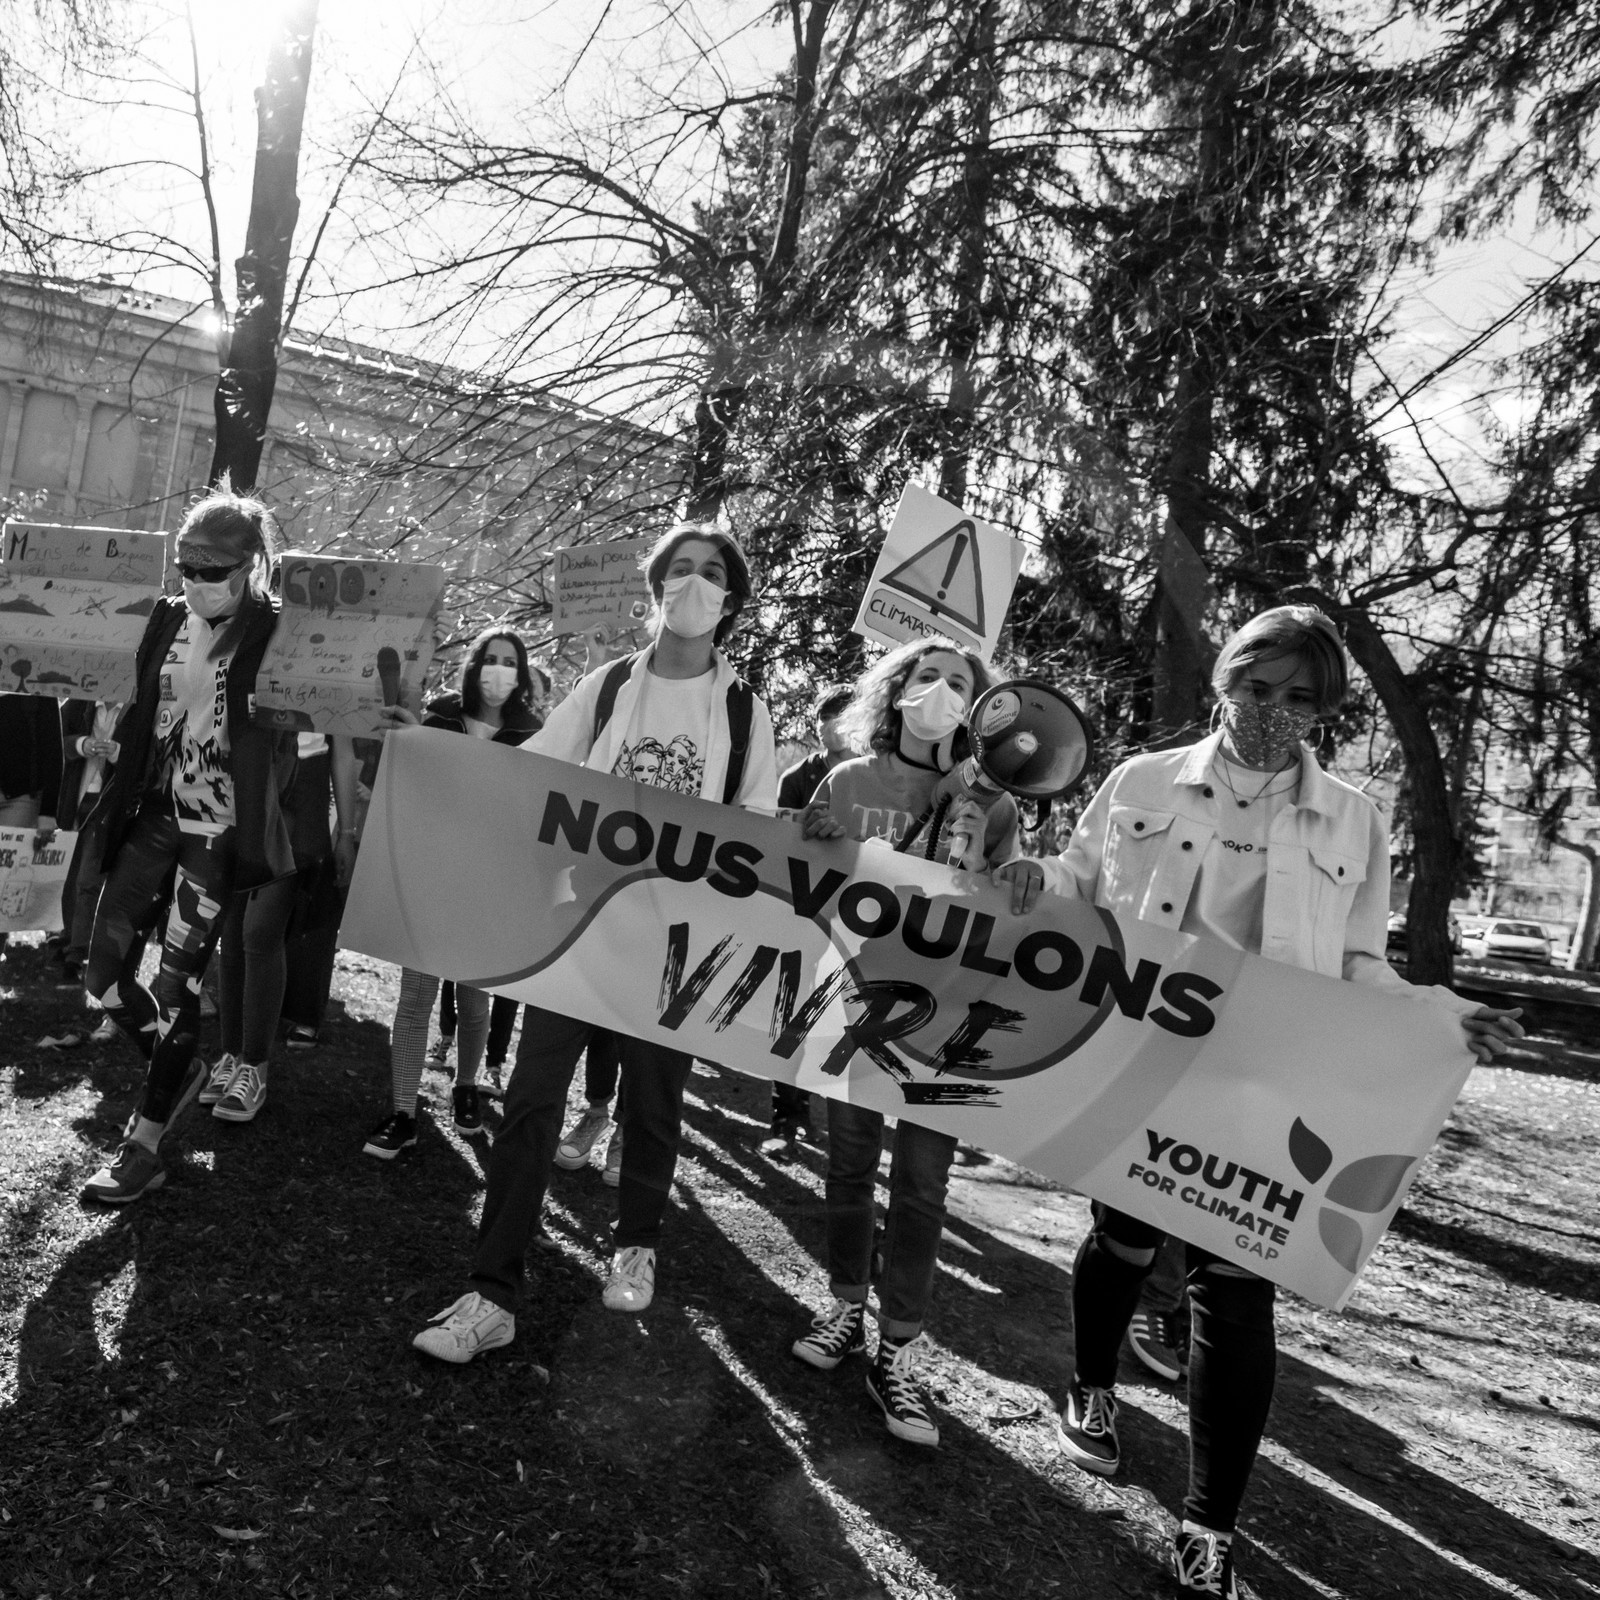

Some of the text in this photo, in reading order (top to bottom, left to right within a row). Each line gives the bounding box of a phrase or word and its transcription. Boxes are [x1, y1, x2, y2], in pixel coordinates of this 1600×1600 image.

[8, 530, 62, 562] Moins
[76, 541, 91, 557] de
[61, 561, 89, 576] plus
[213, 657, 228, 728] EMBRUN
[1221, 840, 1253, 853] YOKO
[537, 790, 1225, 1037] NOUS VOULONS
[658, 922, 1027, 1108] VIVRE
[1127, 1162, 1290, 1246] FOR CLIMATE
[1146, 1128, 1305, 1223] YOUTH
[1235, 1234, 1279, 1260] GAP
